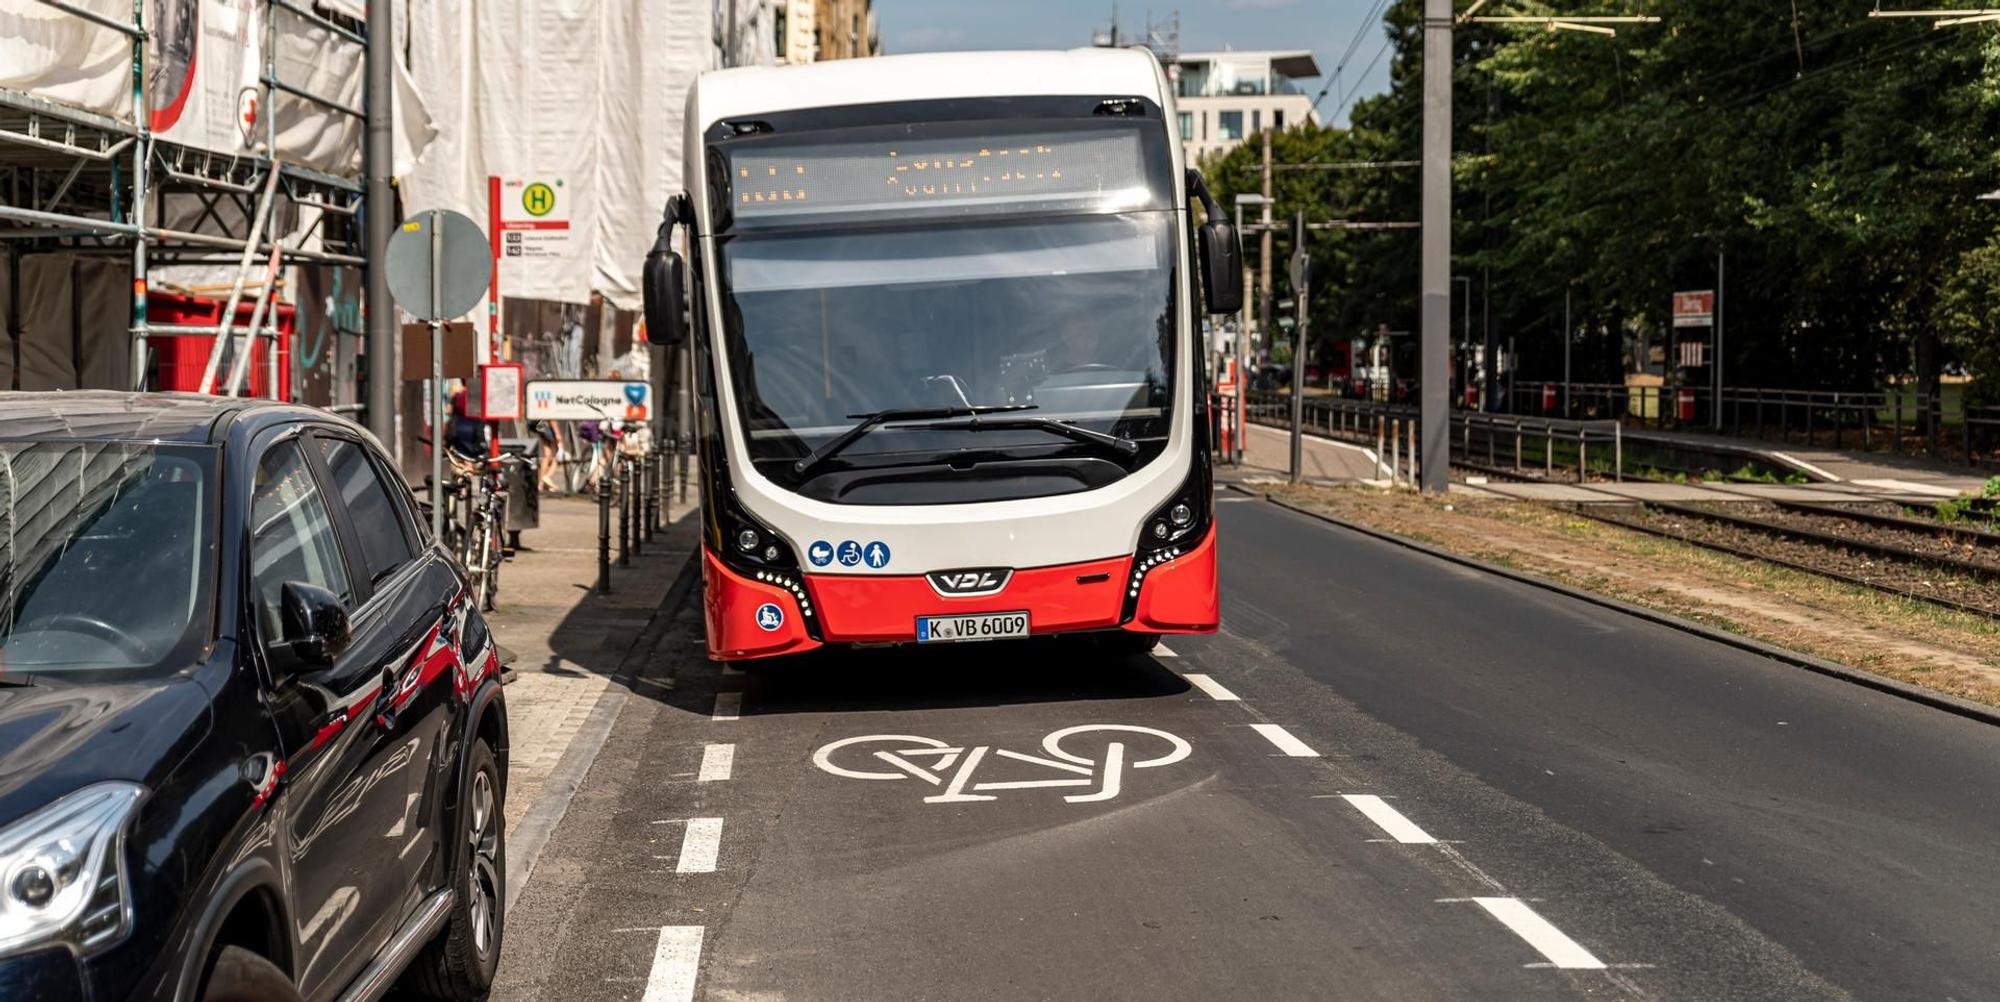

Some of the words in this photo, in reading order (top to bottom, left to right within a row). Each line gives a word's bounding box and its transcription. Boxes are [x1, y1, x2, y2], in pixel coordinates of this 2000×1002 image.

[531, 190, 546, 209] H
[556, 395, 622, 406] NetCologne
[940, 572, 998, 589] VDL
[930, 620, 942, 638] K
[954, 619, 977, 637] VB
[981, 616, 1025, 635] 6009
